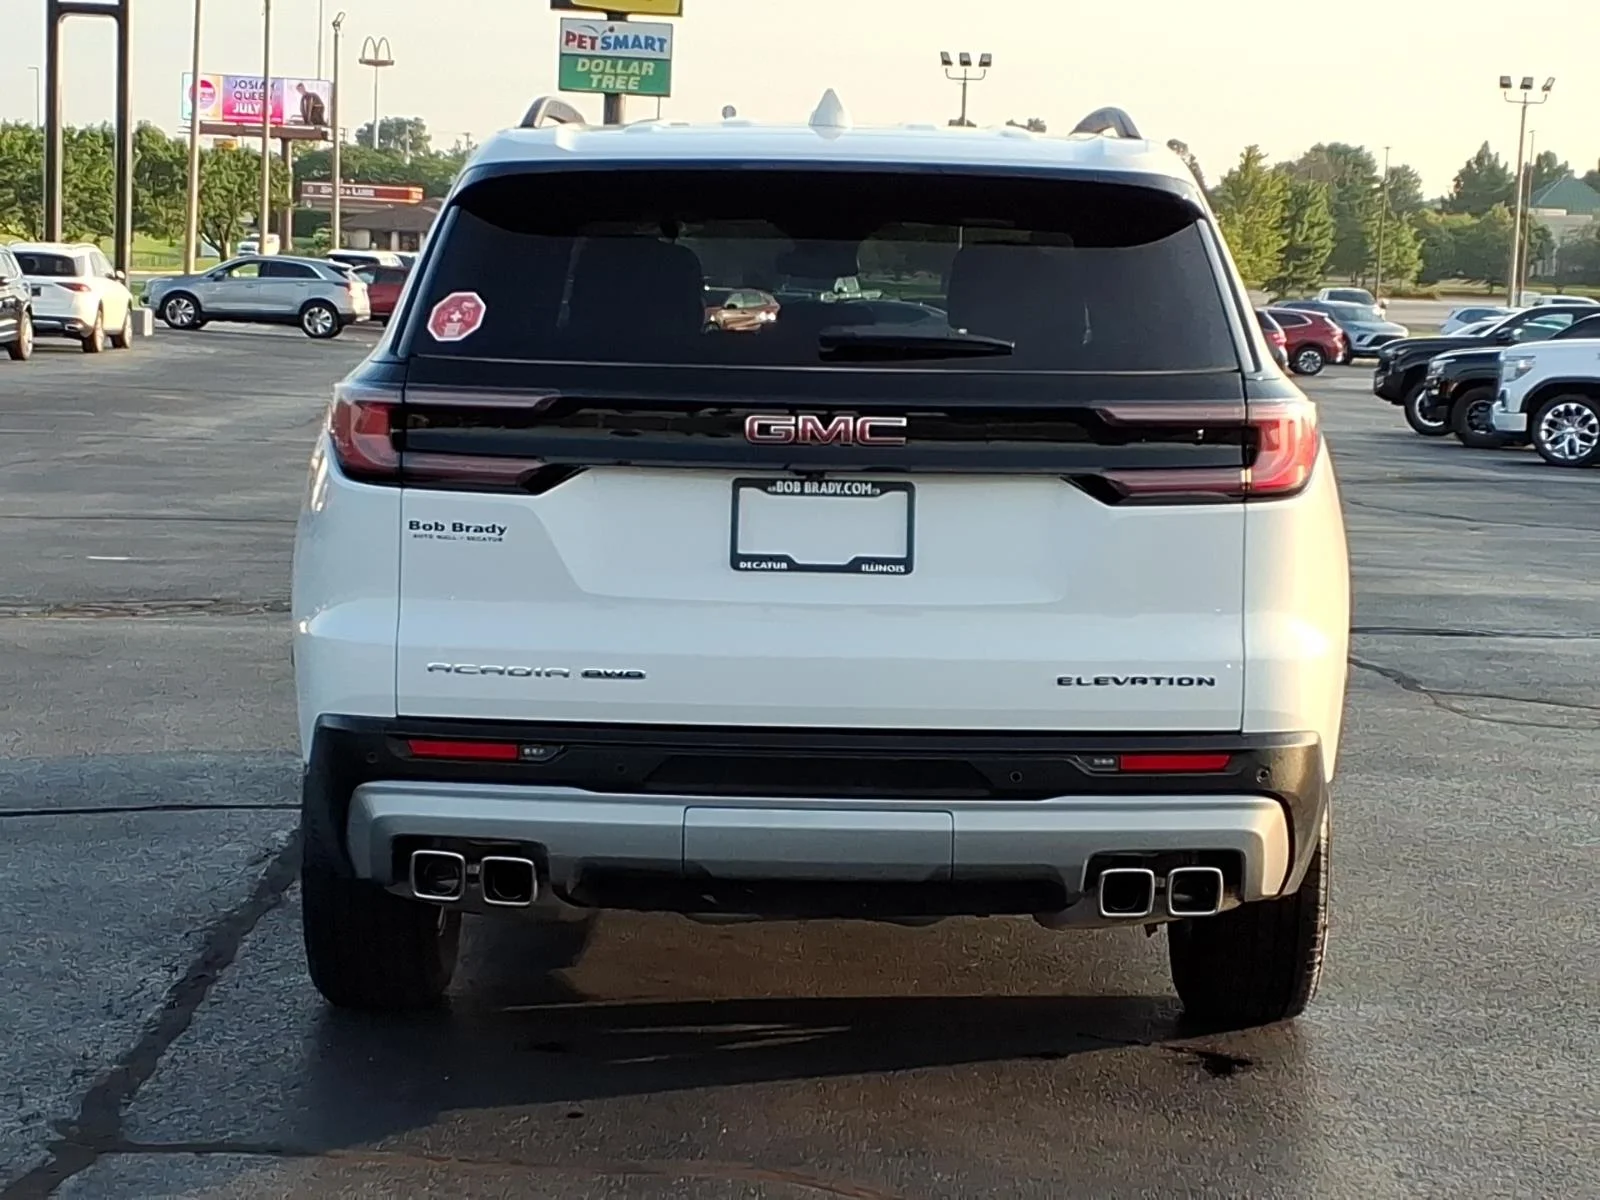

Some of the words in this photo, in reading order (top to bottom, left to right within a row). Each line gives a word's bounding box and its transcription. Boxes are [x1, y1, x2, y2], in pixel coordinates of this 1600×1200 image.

[565, 30, 667, 53] PETSMART
[576, 58, 655, 76] DOLLAR
[589, 73, 641, 90] TREE
[234, 91, 273, 101] QUEE
[232, 103, 260, 115] JULY
[745, 415, 907, 445] GMC
[776, 480, 801, 493] BOB
[804, 481, 873, 495] BRADY.COM
[408, 520, 445, 532] Bob
[452, 522, 507, 536] Brady
[739, 561, 788, 570] DECATUR
[861, 563, 905, 573] ILLINOIS
[427, 662, 570, 678] ACADIA
[1057, 675, 1216, 688] ELEVATION
